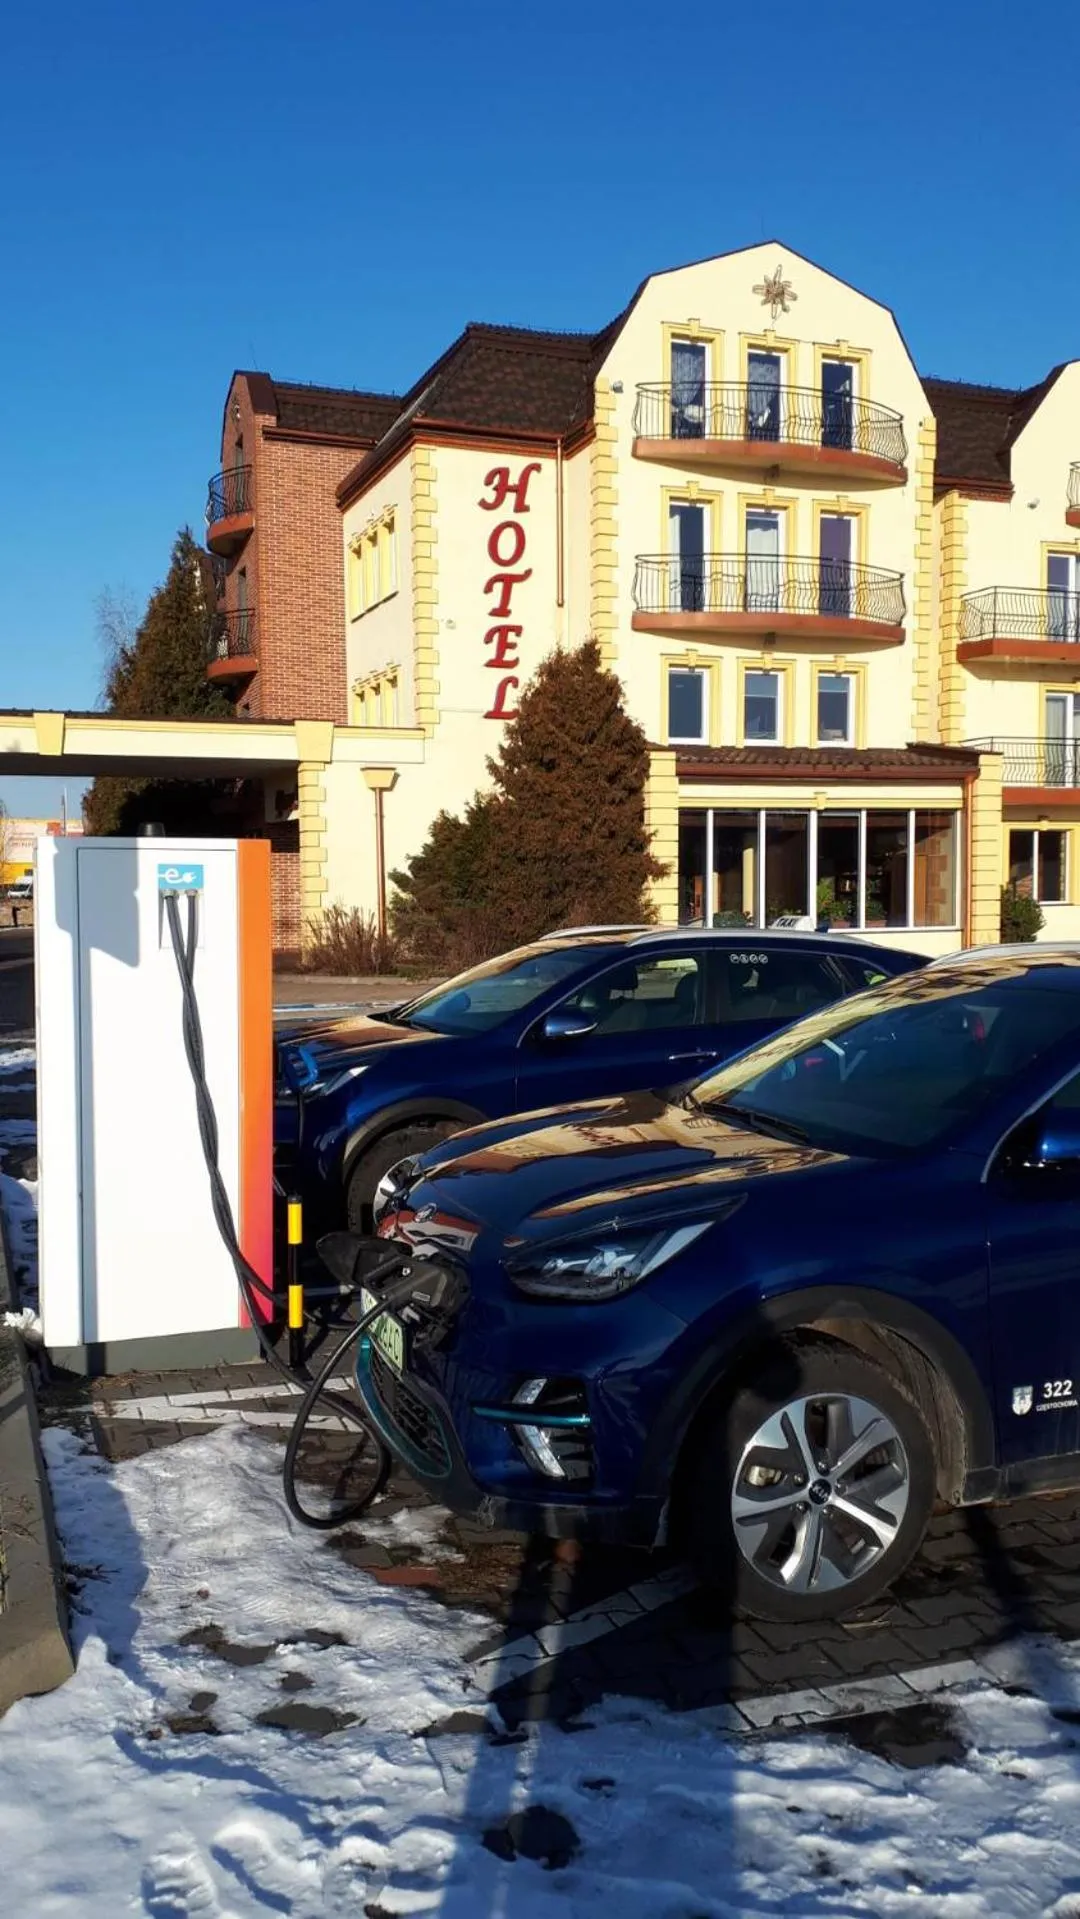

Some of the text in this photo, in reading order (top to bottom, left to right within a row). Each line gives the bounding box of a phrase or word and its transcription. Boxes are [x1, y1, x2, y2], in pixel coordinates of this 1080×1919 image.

[478, 463, 542, 721] HOTEL
[776, 918, 799, 928] TAXI
[1043, 1379, 1073, 1399] 322
